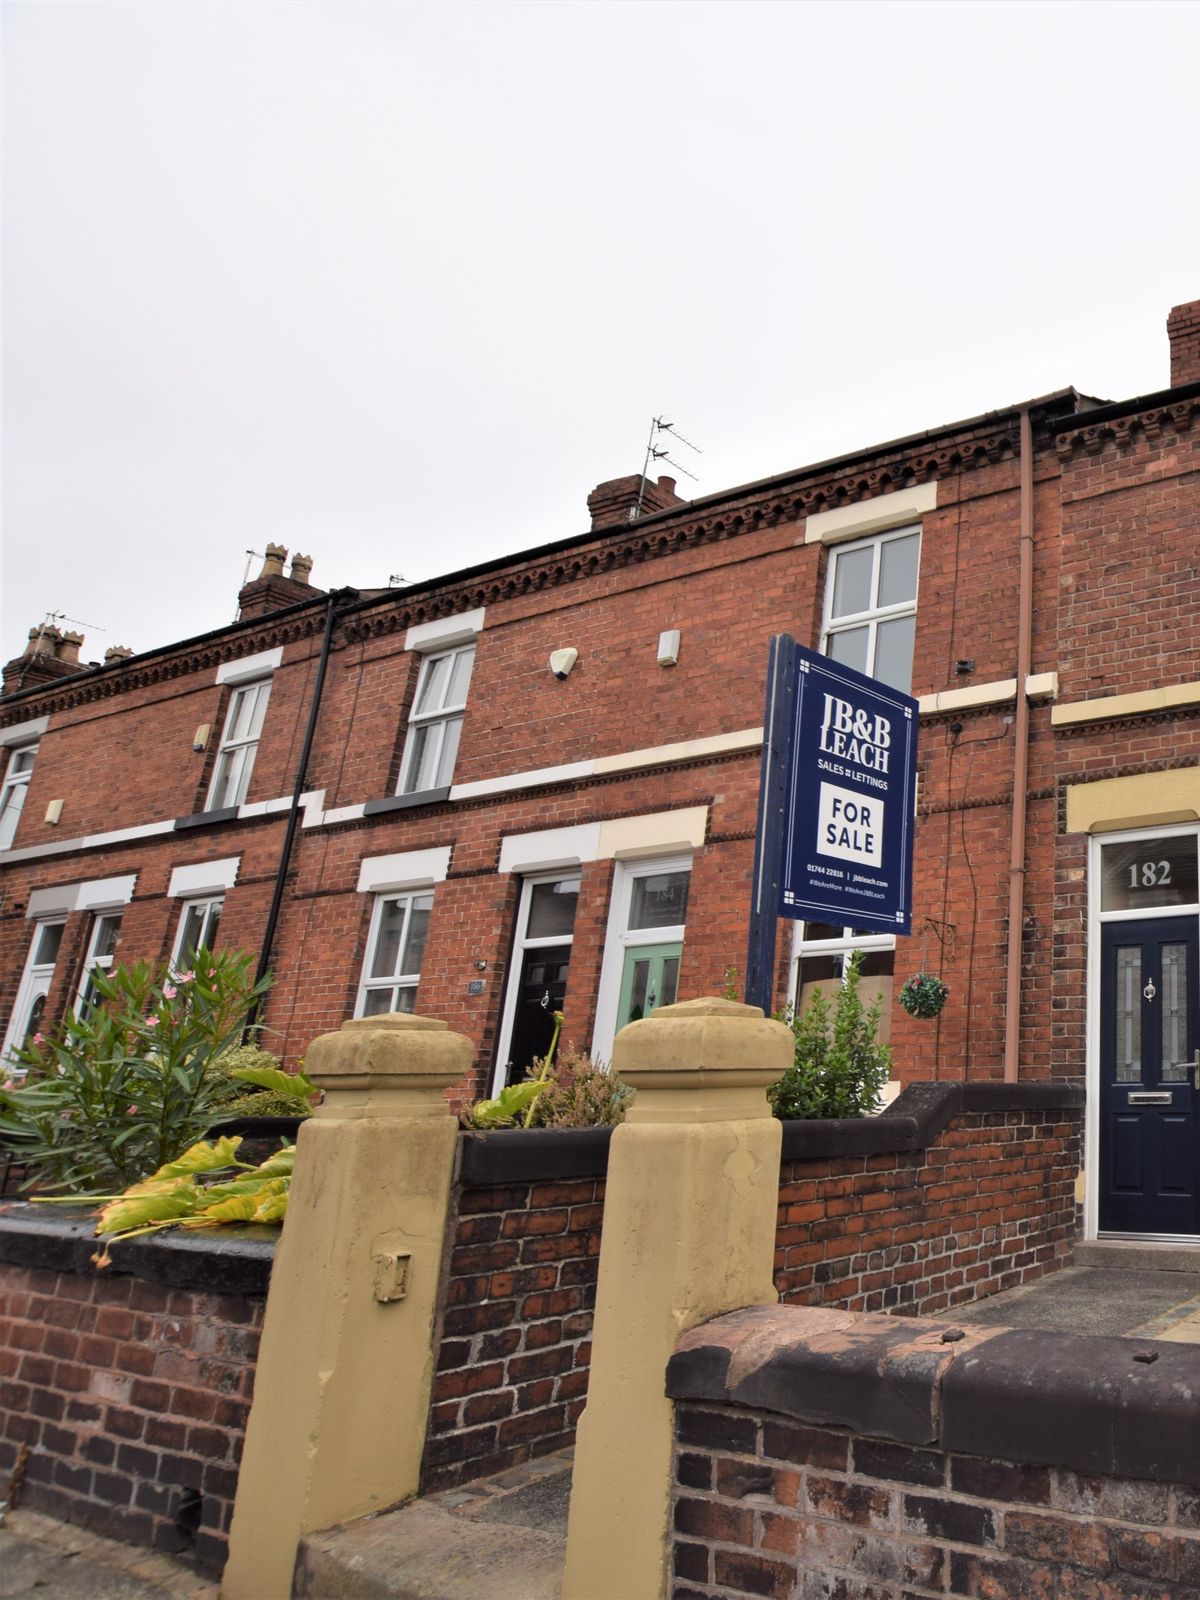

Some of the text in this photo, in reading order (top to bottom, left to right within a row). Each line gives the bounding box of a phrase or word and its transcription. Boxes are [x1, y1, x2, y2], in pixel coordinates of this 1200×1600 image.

[821, 693, 891, 749] JB&B
[819, 725, 890, 774] LEACH
[817, 758, 888, 791] SALES LETTINGS
[832, 798, 872, 828] FOR
[826, 823, 874, 854] SALE
[806, 864, 825, 874] 01744
[852, 873, 888, 888] jbbleach.com
[1127, 860, 1172, 888] 182
